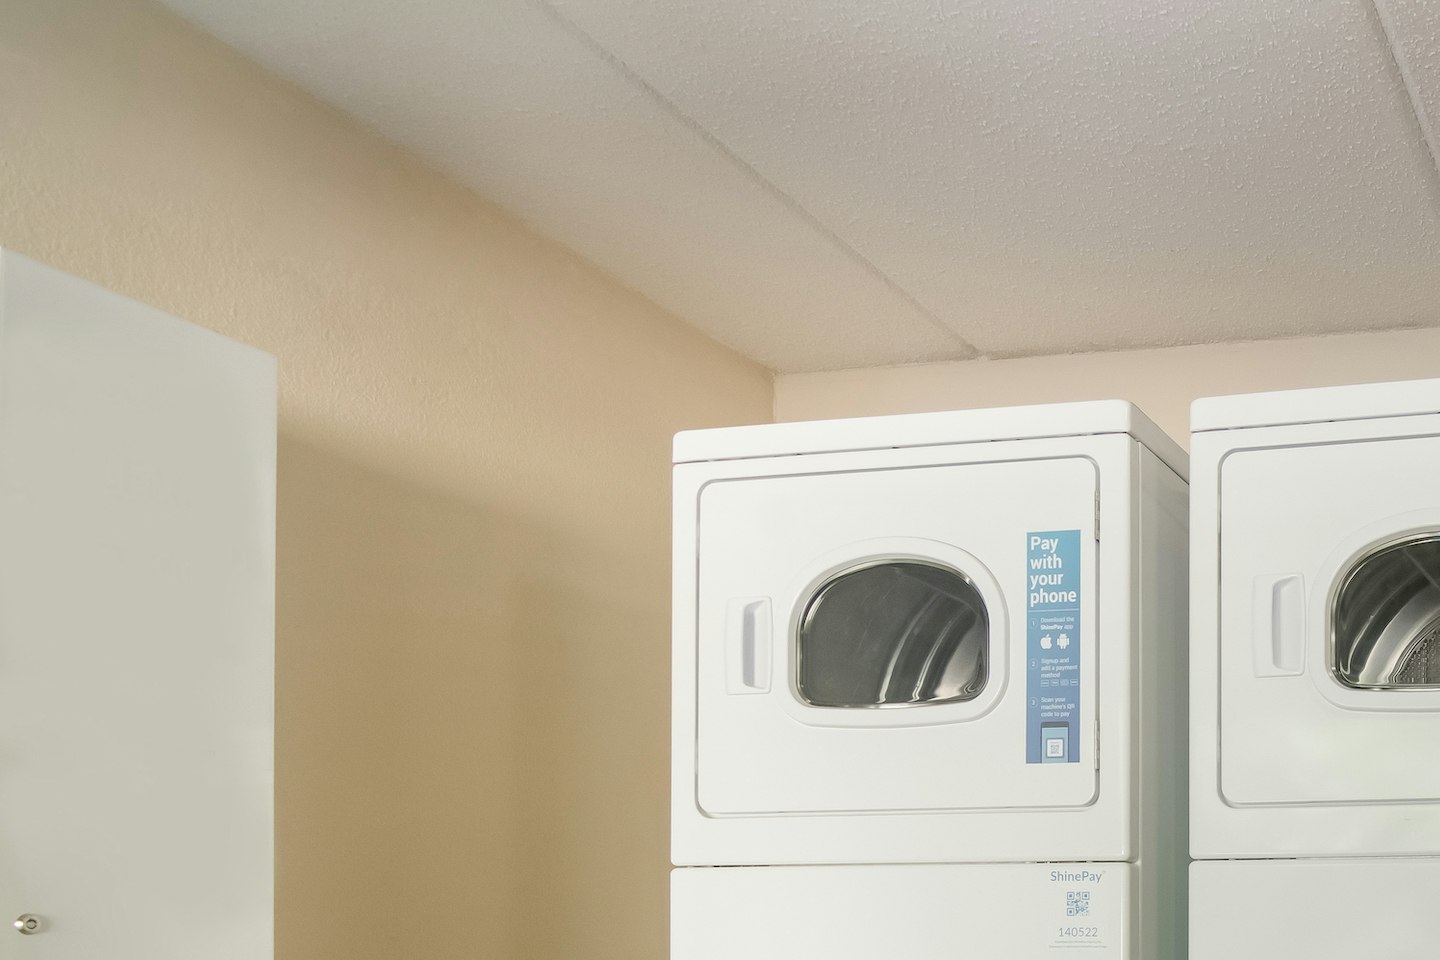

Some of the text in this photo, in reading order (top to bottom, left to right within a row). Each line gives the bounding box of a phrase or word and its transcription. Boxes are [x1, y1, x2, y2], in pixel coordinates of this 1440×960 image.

[1030, 536, 1059, 554] Pay
[1030, 554, 1062, 570] with
[1030, 571, 1064, 590] your
[1030, 588, 1077, 607] phone
[1050, 870, 1102, 883] ShinePay
[1059, 927, 1098, 937] 140522
